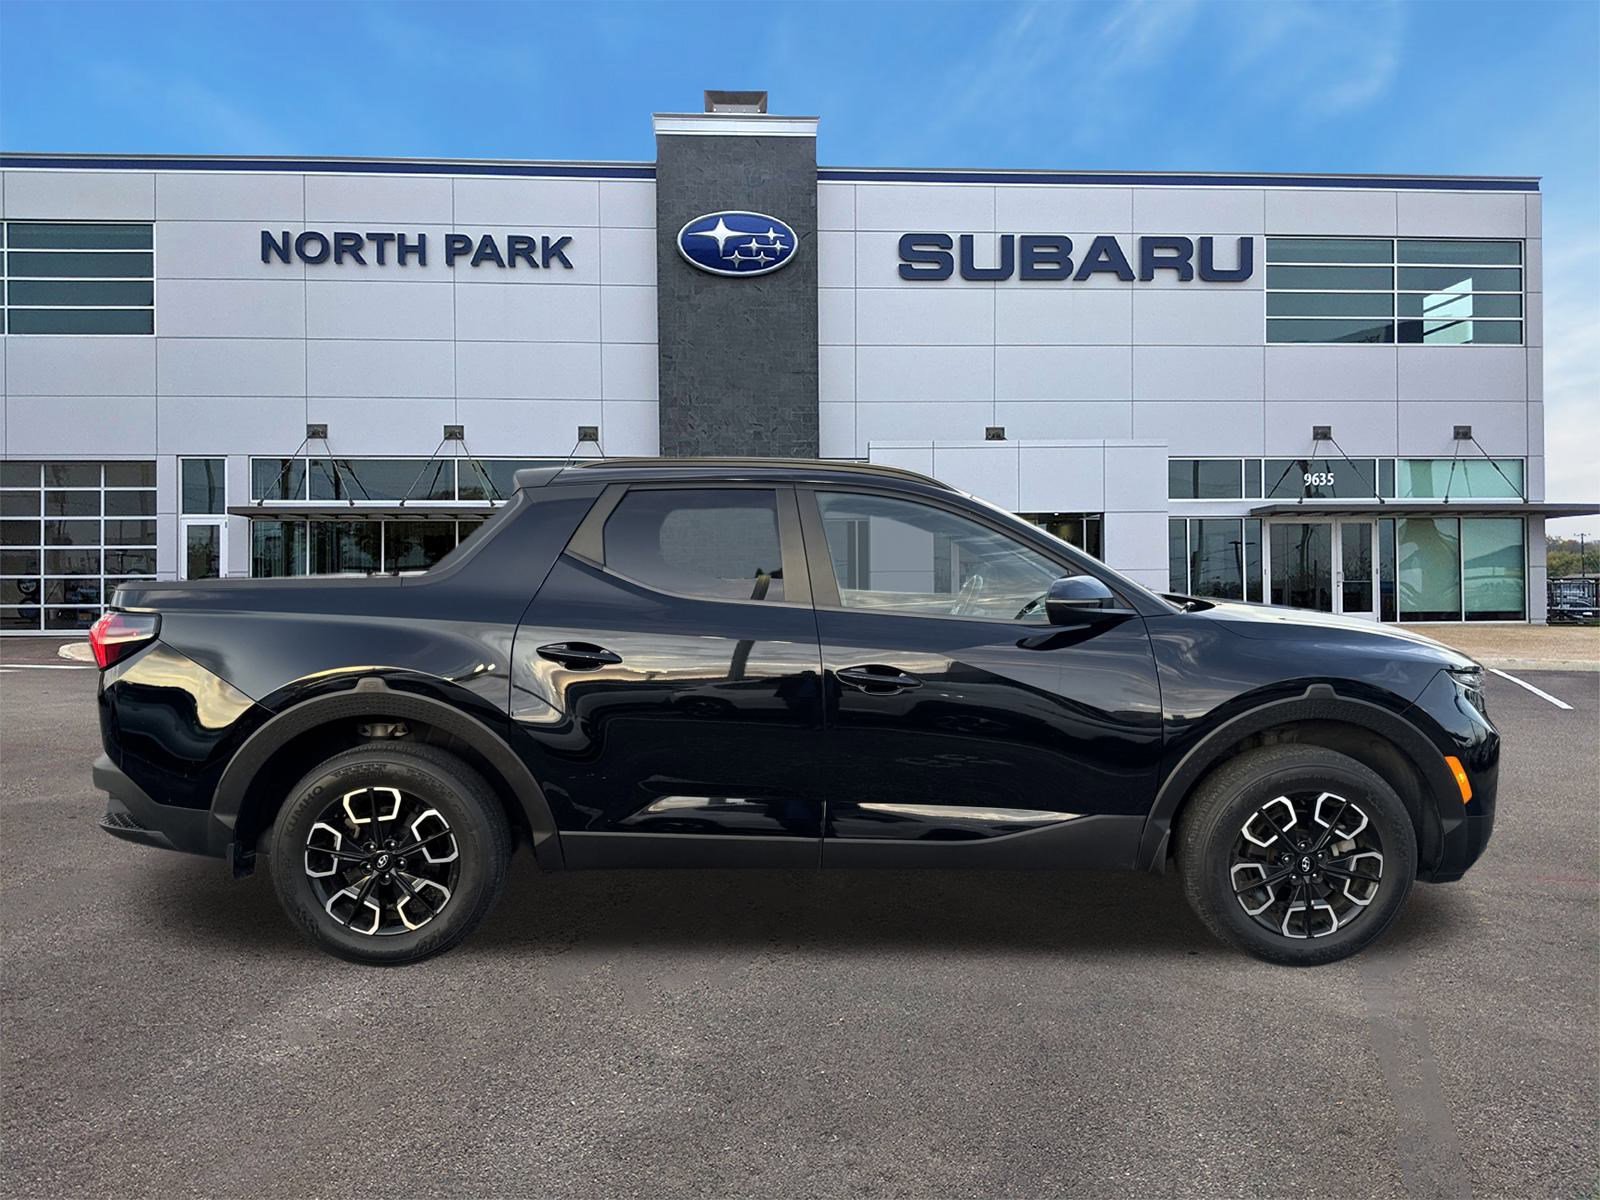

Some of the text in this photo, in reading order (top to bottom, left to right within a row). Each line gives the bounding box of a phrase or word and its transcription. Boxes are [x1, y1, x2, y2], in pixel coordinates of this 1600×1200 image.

[261, 230, 574, 269] NORTH PARK
[898, 232, 1254, 282] SUBARU
[1303, 472, 1335, 486] 9635
[284, 785, 323, 837] KUMHO
